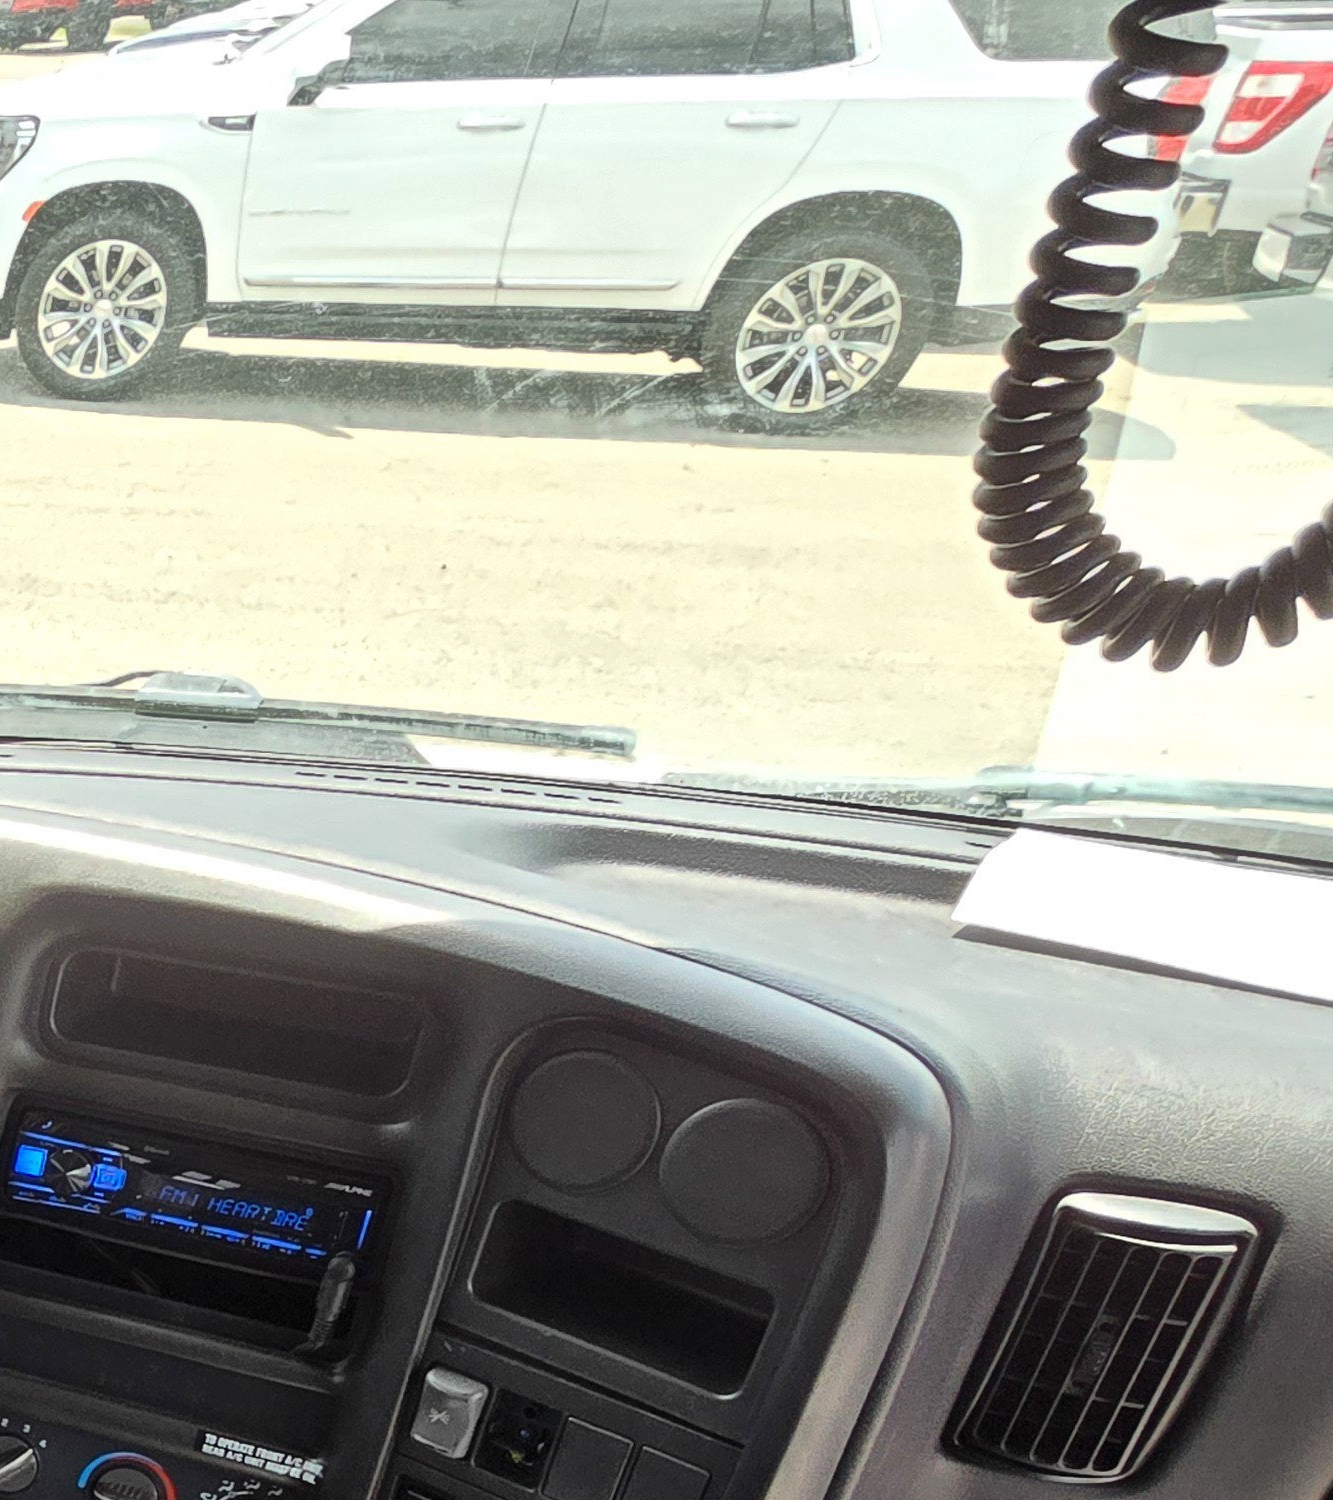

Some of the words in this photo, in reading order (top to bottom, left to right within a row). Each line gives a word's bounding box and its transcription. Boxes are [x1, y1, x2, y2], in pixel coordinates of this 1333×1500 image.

[1, 1418, 9, 1428] 2
[23, 1424, 31, 1433] 3
[39, 1440, 47, 1448] 4
[217, 1437, 255, 1456] OPERATE
[255, 1447, 285, 1463] FRONT
[284, 1455, 303, 1468] A/C
[225, 1451, 243, 1463] A/C
